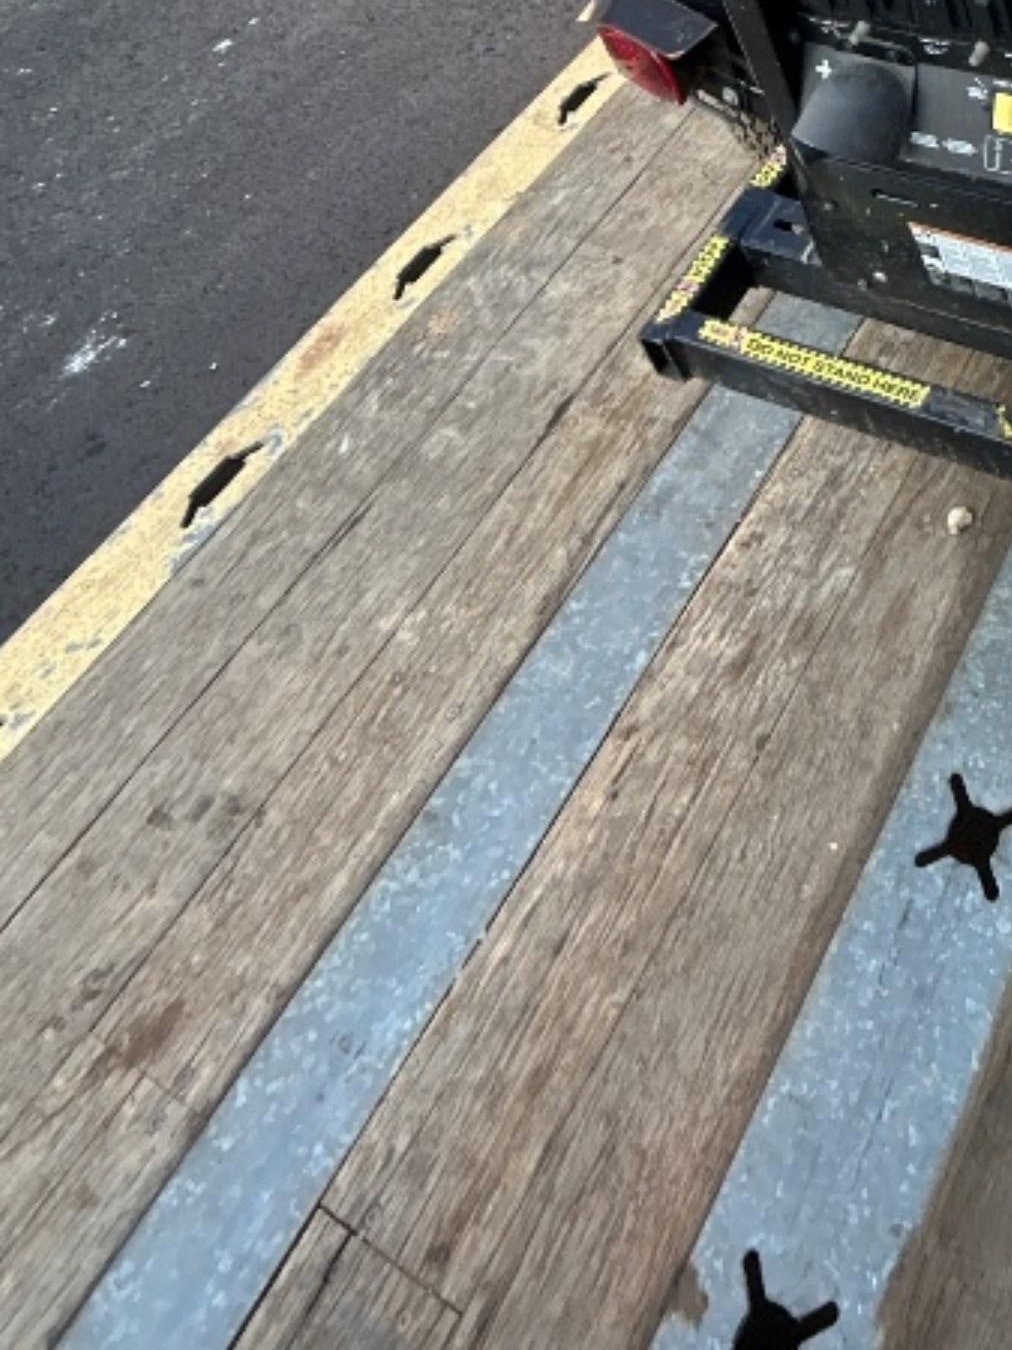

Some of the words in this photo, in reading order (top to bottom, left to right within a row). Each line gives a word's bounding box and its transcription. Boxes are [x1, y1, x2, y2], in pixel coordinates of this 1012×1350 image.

[775, 347, 810, 370] NOT
[813, 359, 871, 386] STAND
[873, 378, 921, 403] HERE
